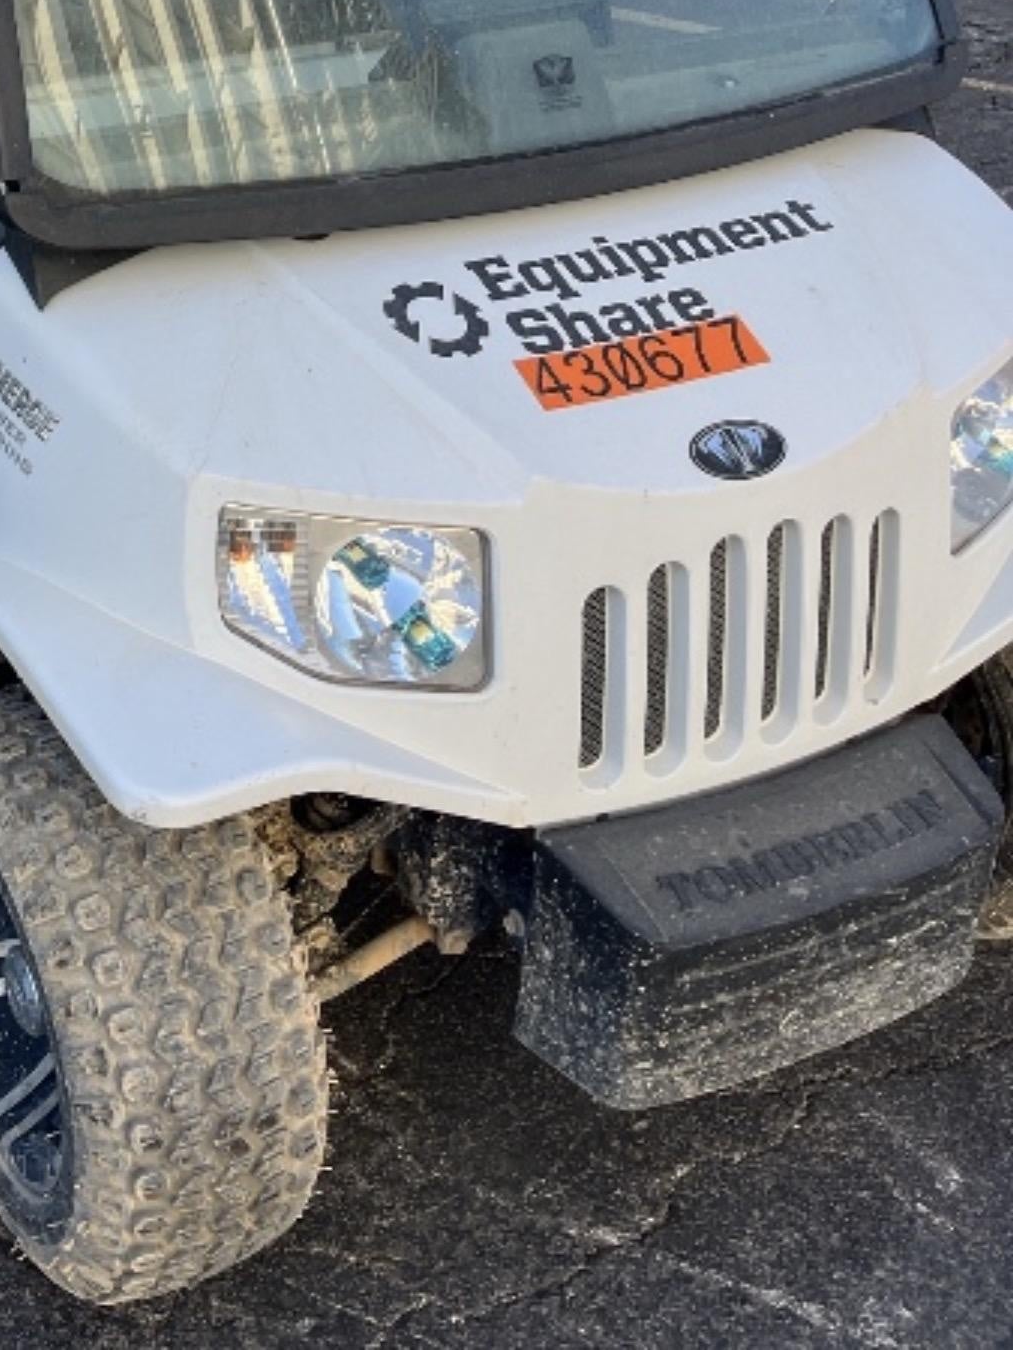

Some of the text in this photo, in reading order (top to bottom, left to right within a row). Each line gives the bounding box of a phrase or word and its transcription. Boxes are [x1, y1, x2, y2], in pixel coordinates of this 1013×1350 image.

[464, 199, 834, 300] Equipment
[505, 286, 715, 355] Share
[535, 314, 749, 403] 430677
[656, 788, 945, 913] TOMBERLIN
